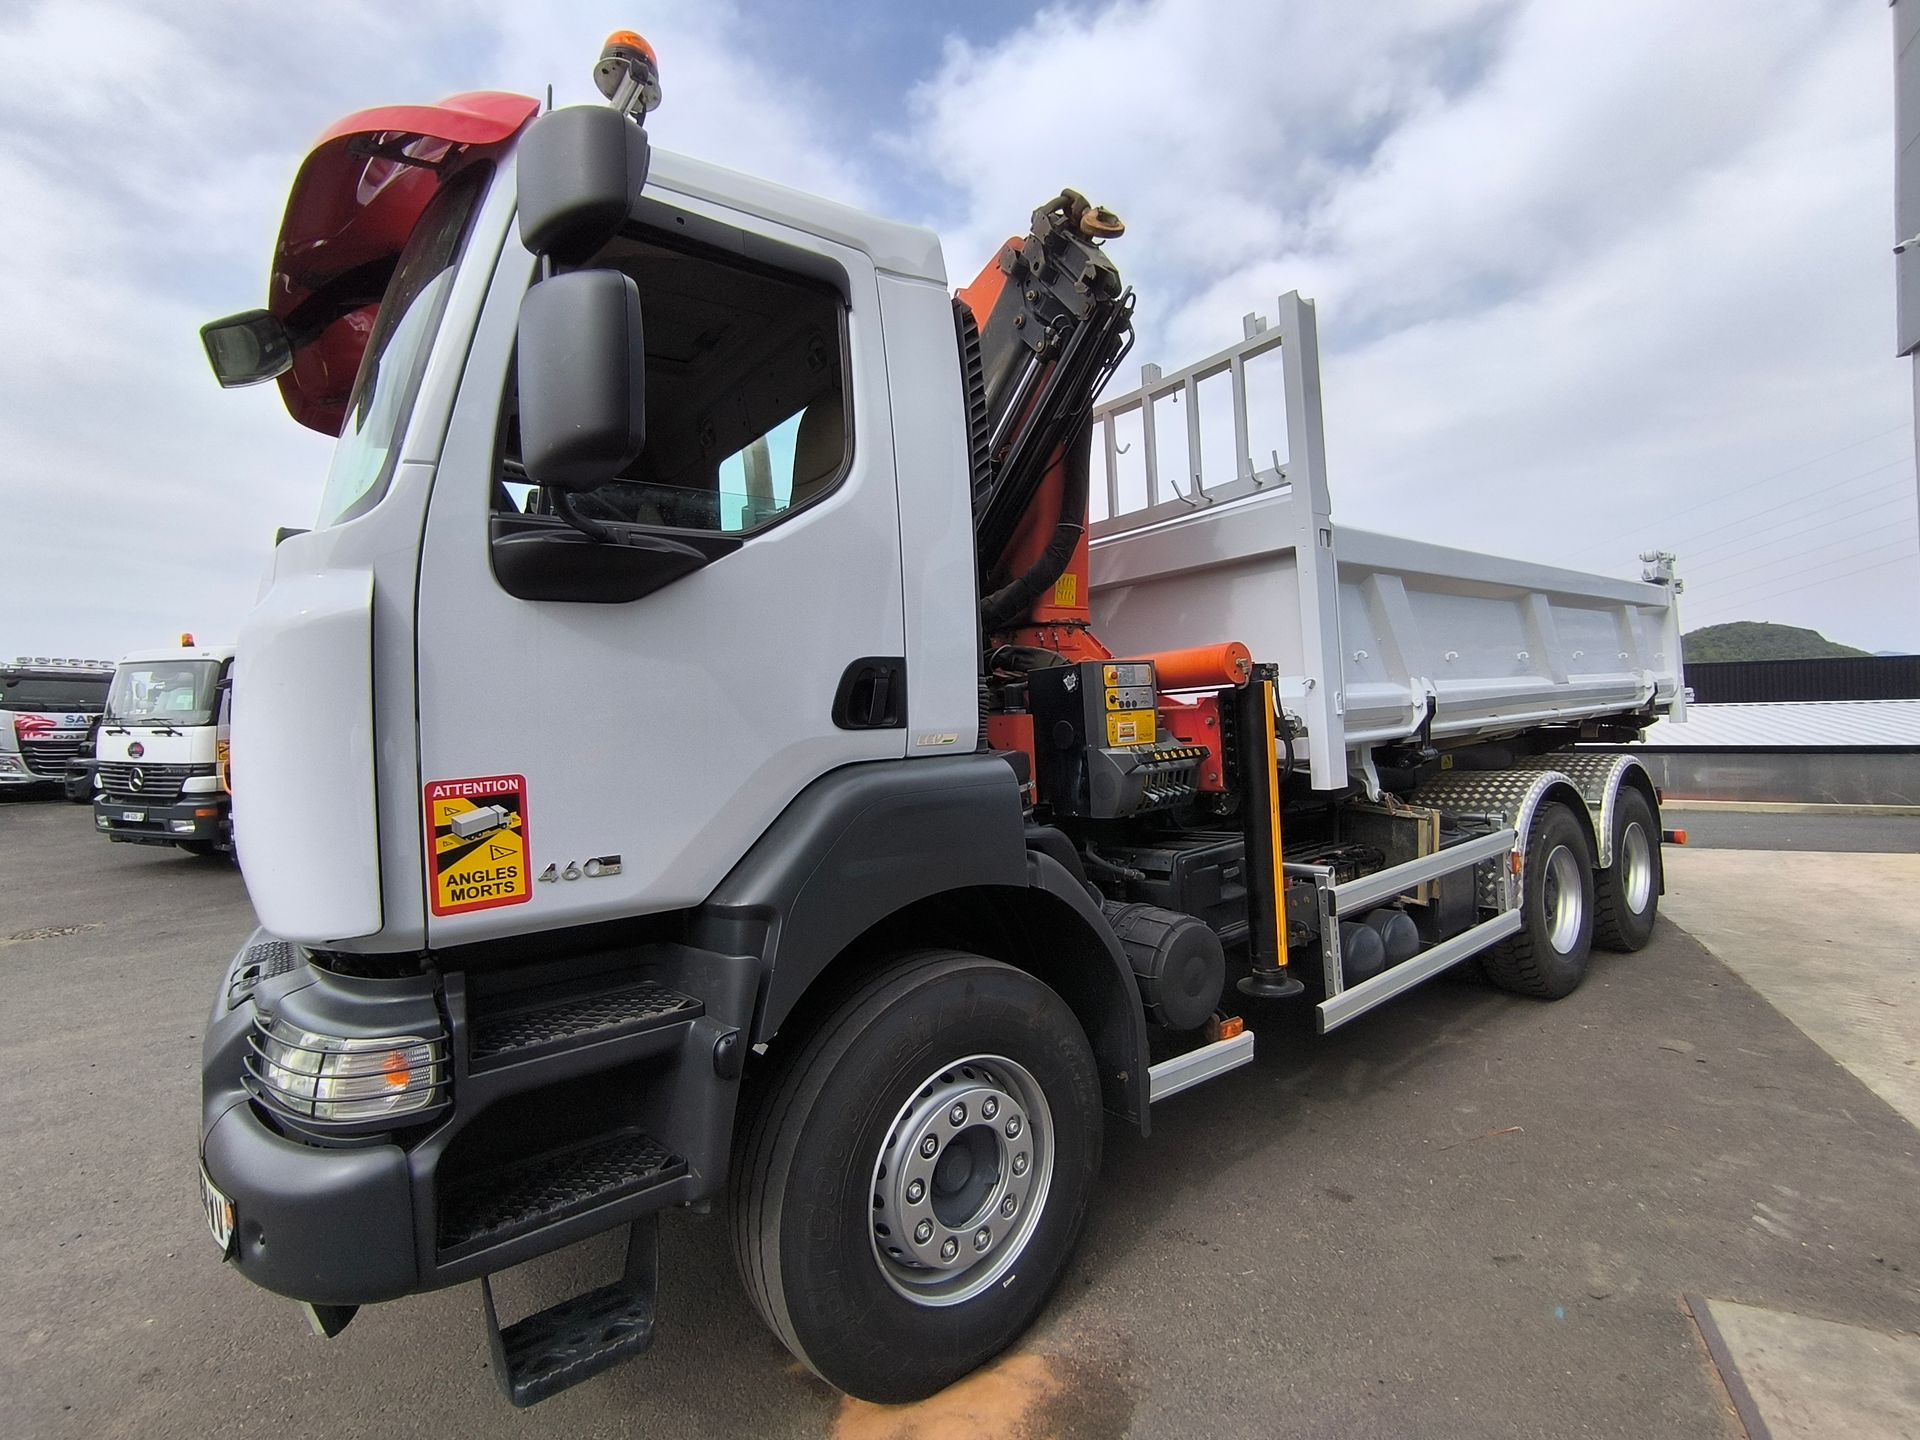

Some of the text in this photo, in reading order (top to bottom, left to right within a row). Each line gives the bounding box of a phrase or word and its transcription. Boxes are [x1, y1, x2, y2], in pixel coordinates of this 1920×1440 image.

[432, 779, 519, 798] ATTENTION
[446, 865, 518, 888] ANGLES
[538, 857, 603, 883] 460
[451, 881, 515, 902] MORTS
